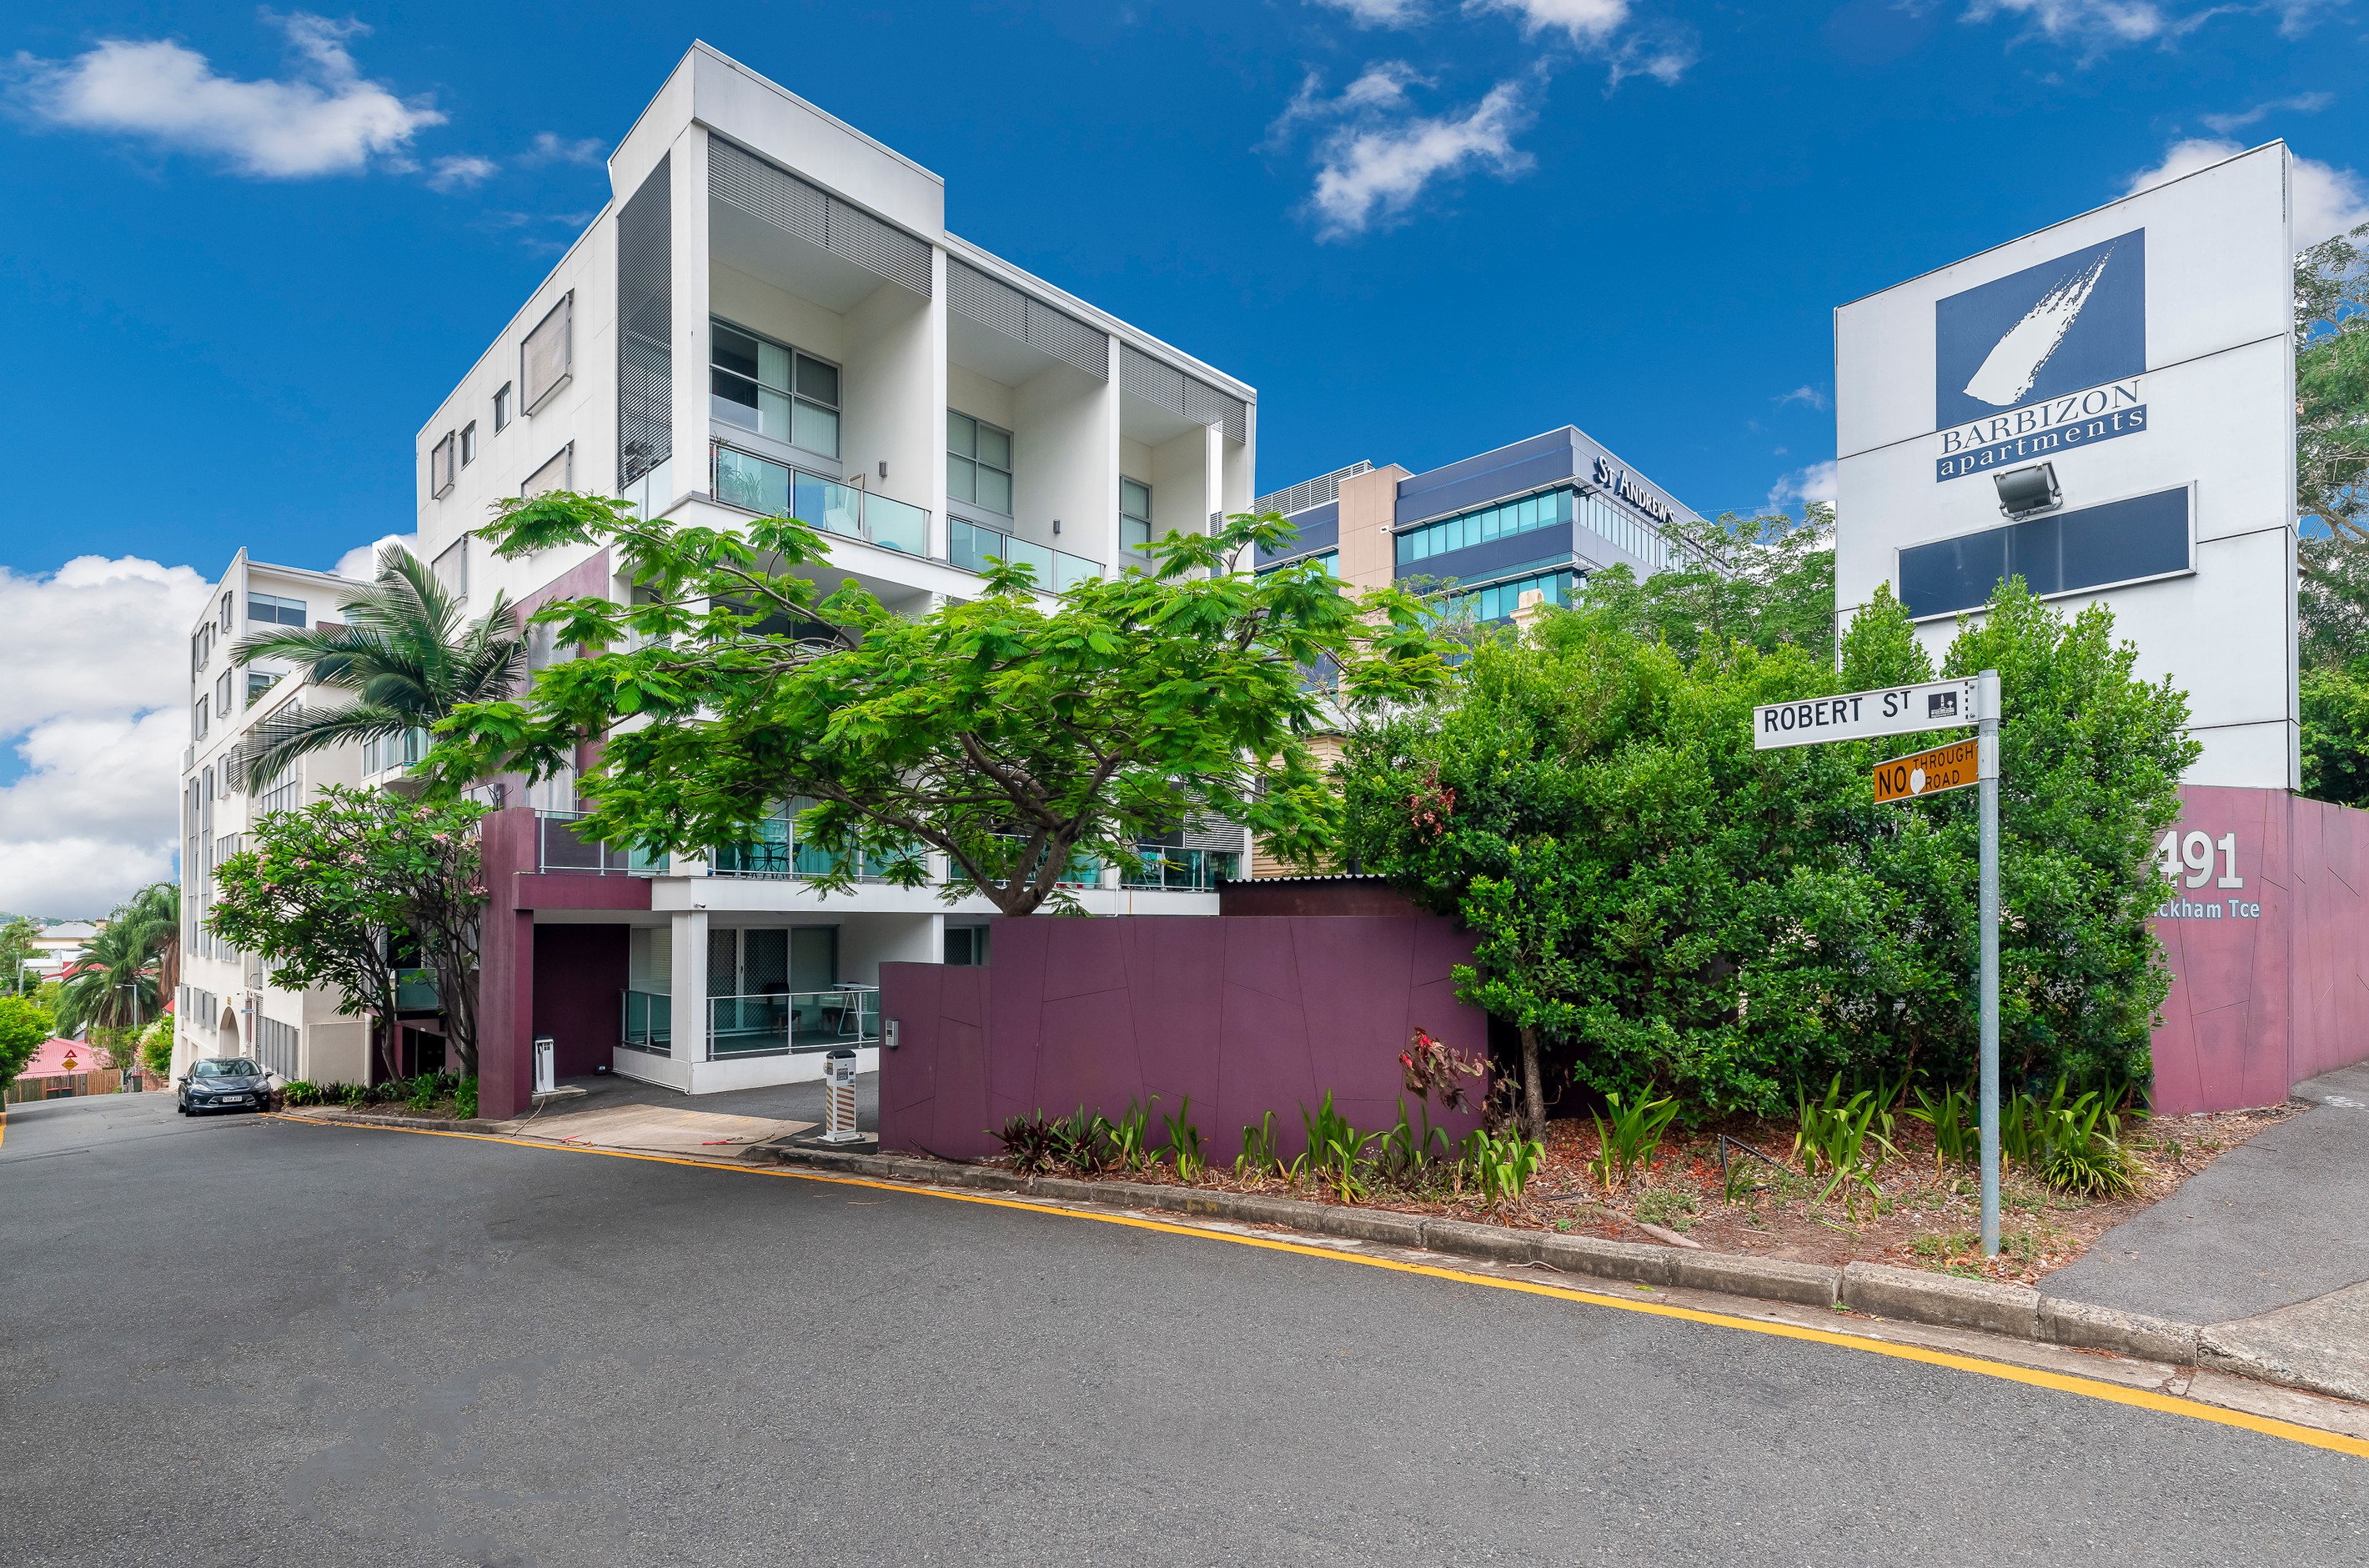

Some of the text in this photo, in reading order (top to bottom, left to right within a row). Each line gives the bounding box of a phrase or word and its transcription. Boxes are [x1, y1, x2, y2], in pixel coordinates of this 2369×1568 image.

[1940, 379, 2141, 456] BARBIZON
[1940, 409, 2144, 478] apartments
[1764, 690, 1911, 733] ROBERT ST
[1913, 744, 1974, 771] THROUGH
[1878, 765, 1907, 797] NO
[1925, 769, 1960, 790] ROAD
[2152, 830, 2243, 889] 491
[2228, 899, 2260, 919] Tce
